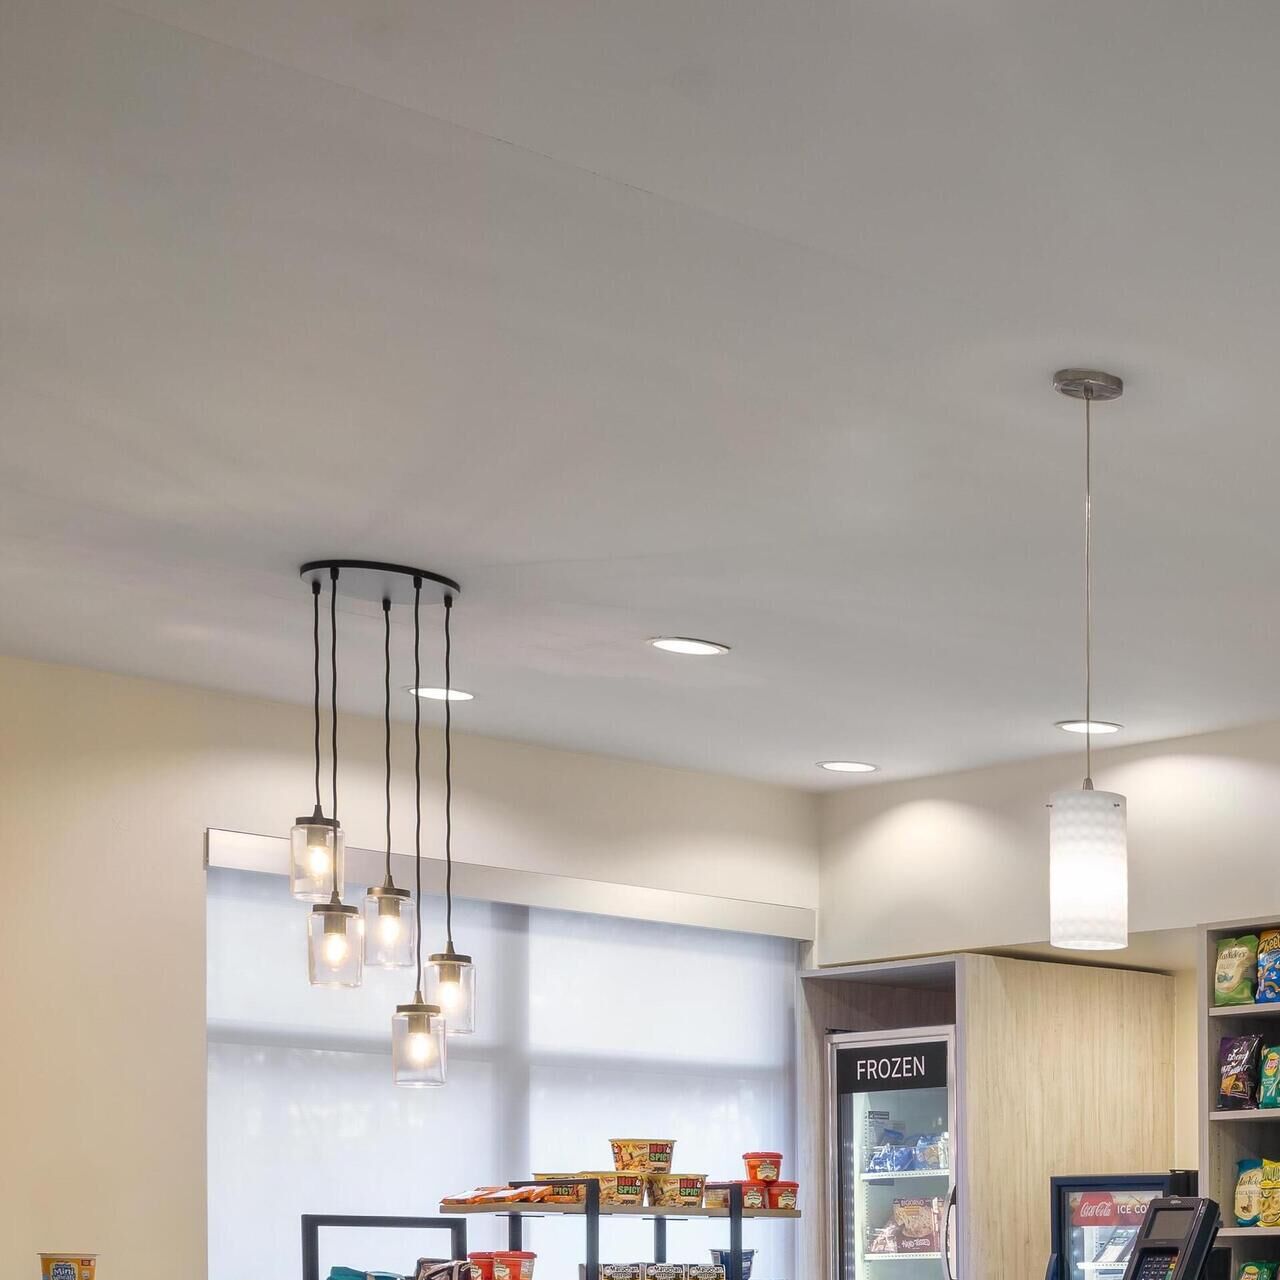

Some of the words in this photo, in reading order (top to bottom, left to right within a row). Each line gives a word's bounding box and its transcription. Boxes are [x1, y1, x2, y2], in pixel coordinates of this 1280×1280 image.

[857, 1056, 925, 1080] FROZEN
[553, 1187, 573, 1195] PICY
[1117, 1204, 1132, 1214] ICE
[1134, 1204, 1150, 1214] CO
[53, 1267, 74, 1276] Mini
